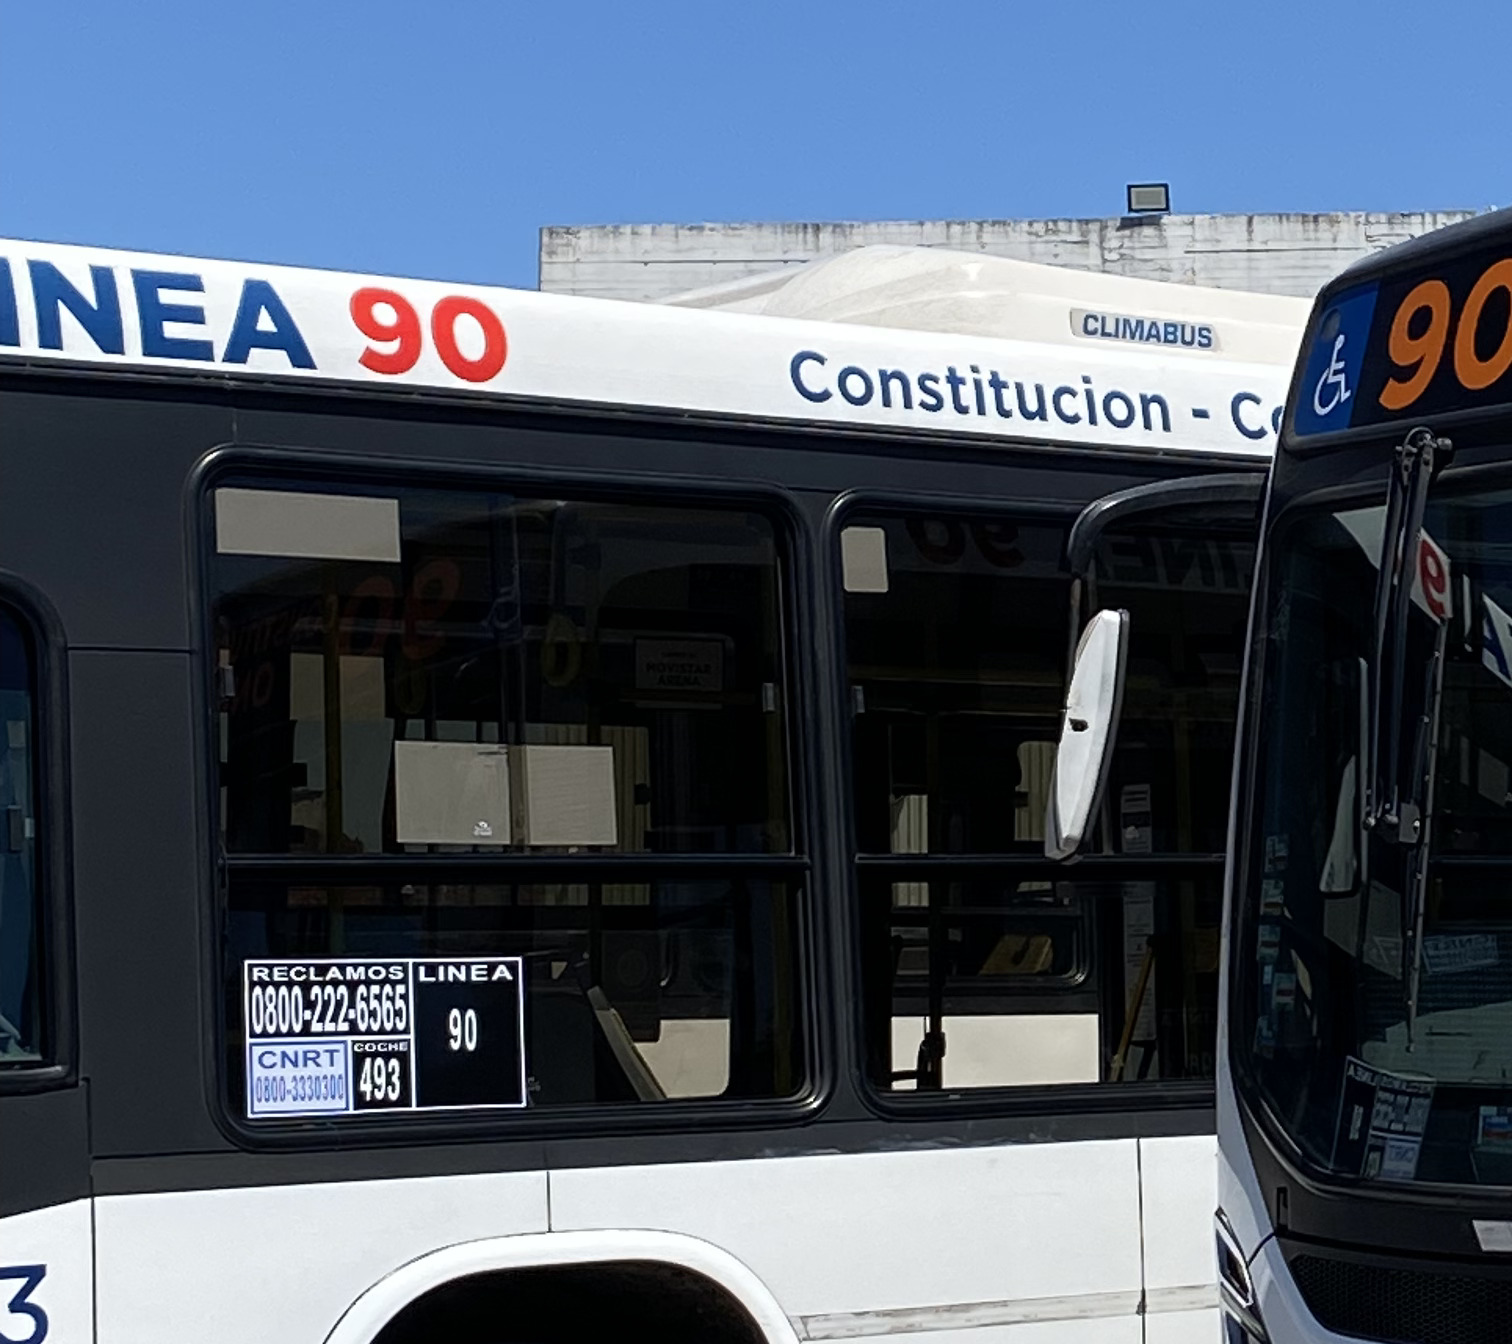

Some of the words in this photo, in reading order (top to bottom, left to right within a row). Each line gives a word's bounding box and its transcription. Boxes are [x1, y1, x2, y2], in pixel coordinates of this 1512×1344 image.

[349, 286, 509, 383] 90
[1082, 313, 1213, 349] CLIMABUS
[789, 350, 1172, 433] Constitucion
[1230, 391, 1284, 440] C
[251, 965, 405, 981] RECLAMOS
[418, 964, 514, 982] LINEA
[251, 983, 407, 1034] 0800-222-6565
[448, 1008, 478, 1052] 90
[257, 1048, 341, 1069] CNRT
[359, 1056, 401, 1102] 493
